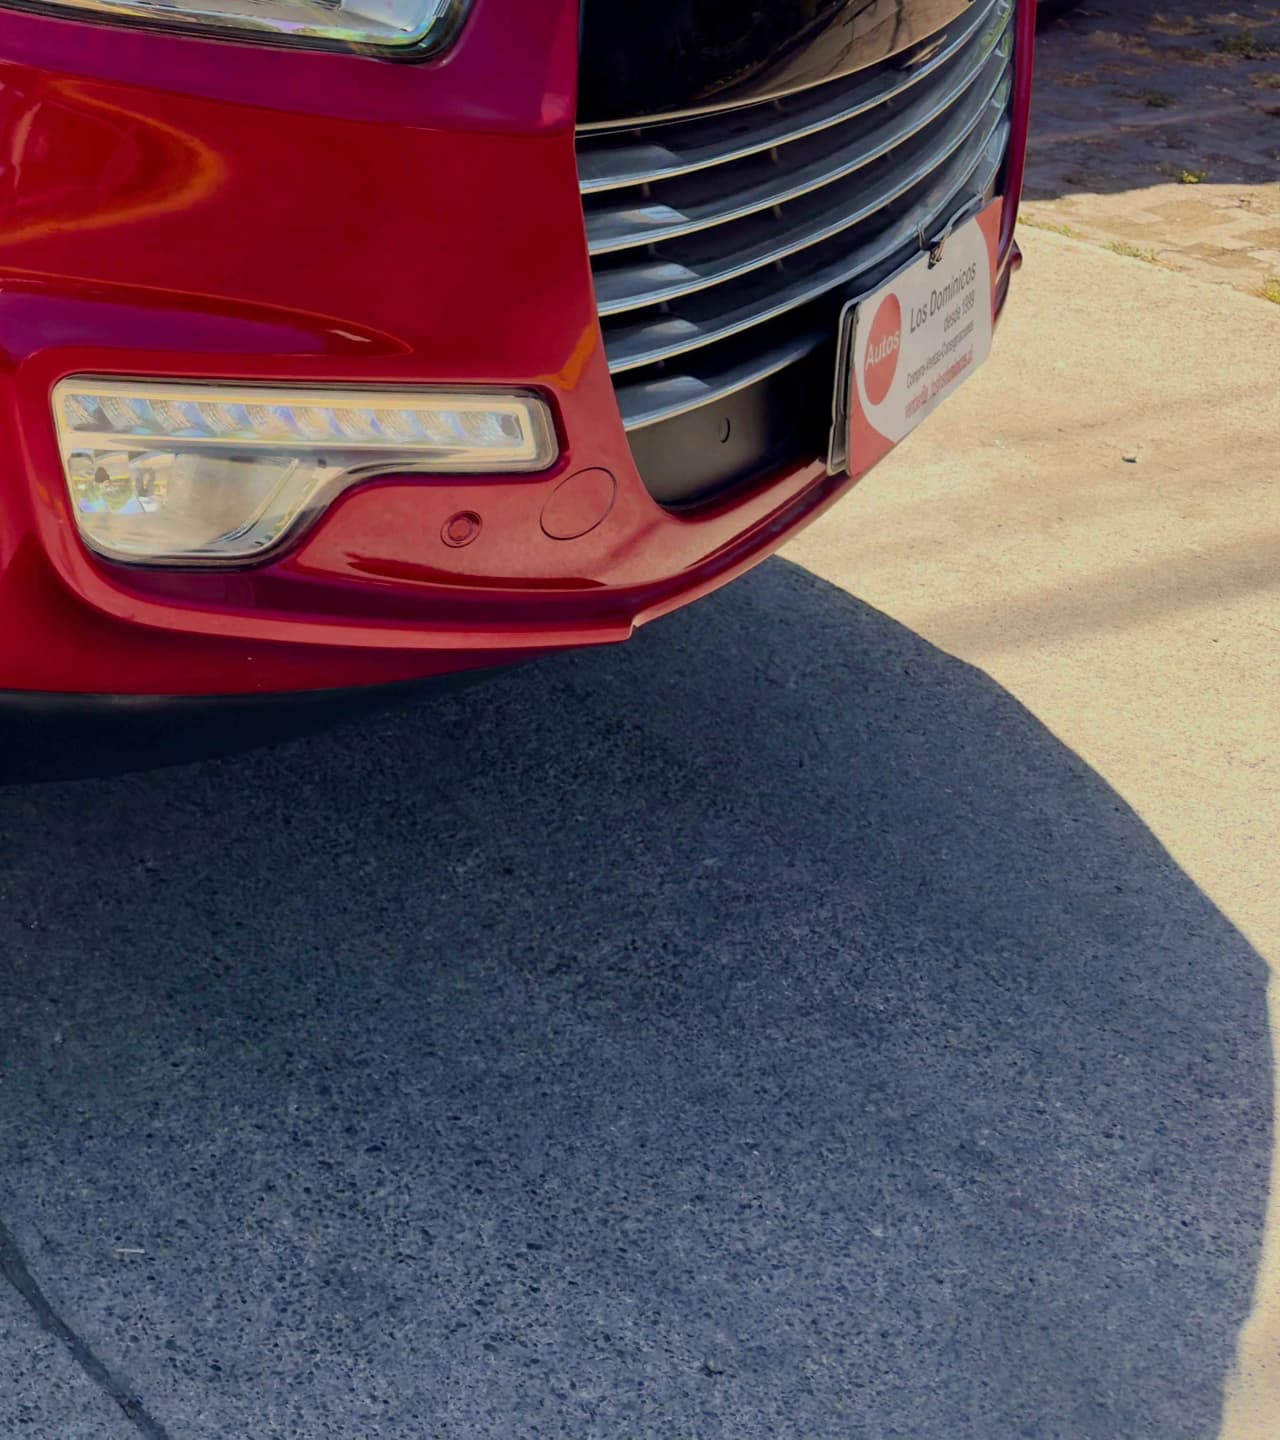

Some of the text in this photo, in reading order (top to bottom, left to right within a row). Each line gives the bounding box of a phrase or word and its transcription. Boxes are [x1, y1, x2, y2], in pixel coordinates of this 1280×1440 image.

[909, 262, 977, 335] Los Dominicos
[864, 329, 901, 368] Autos
